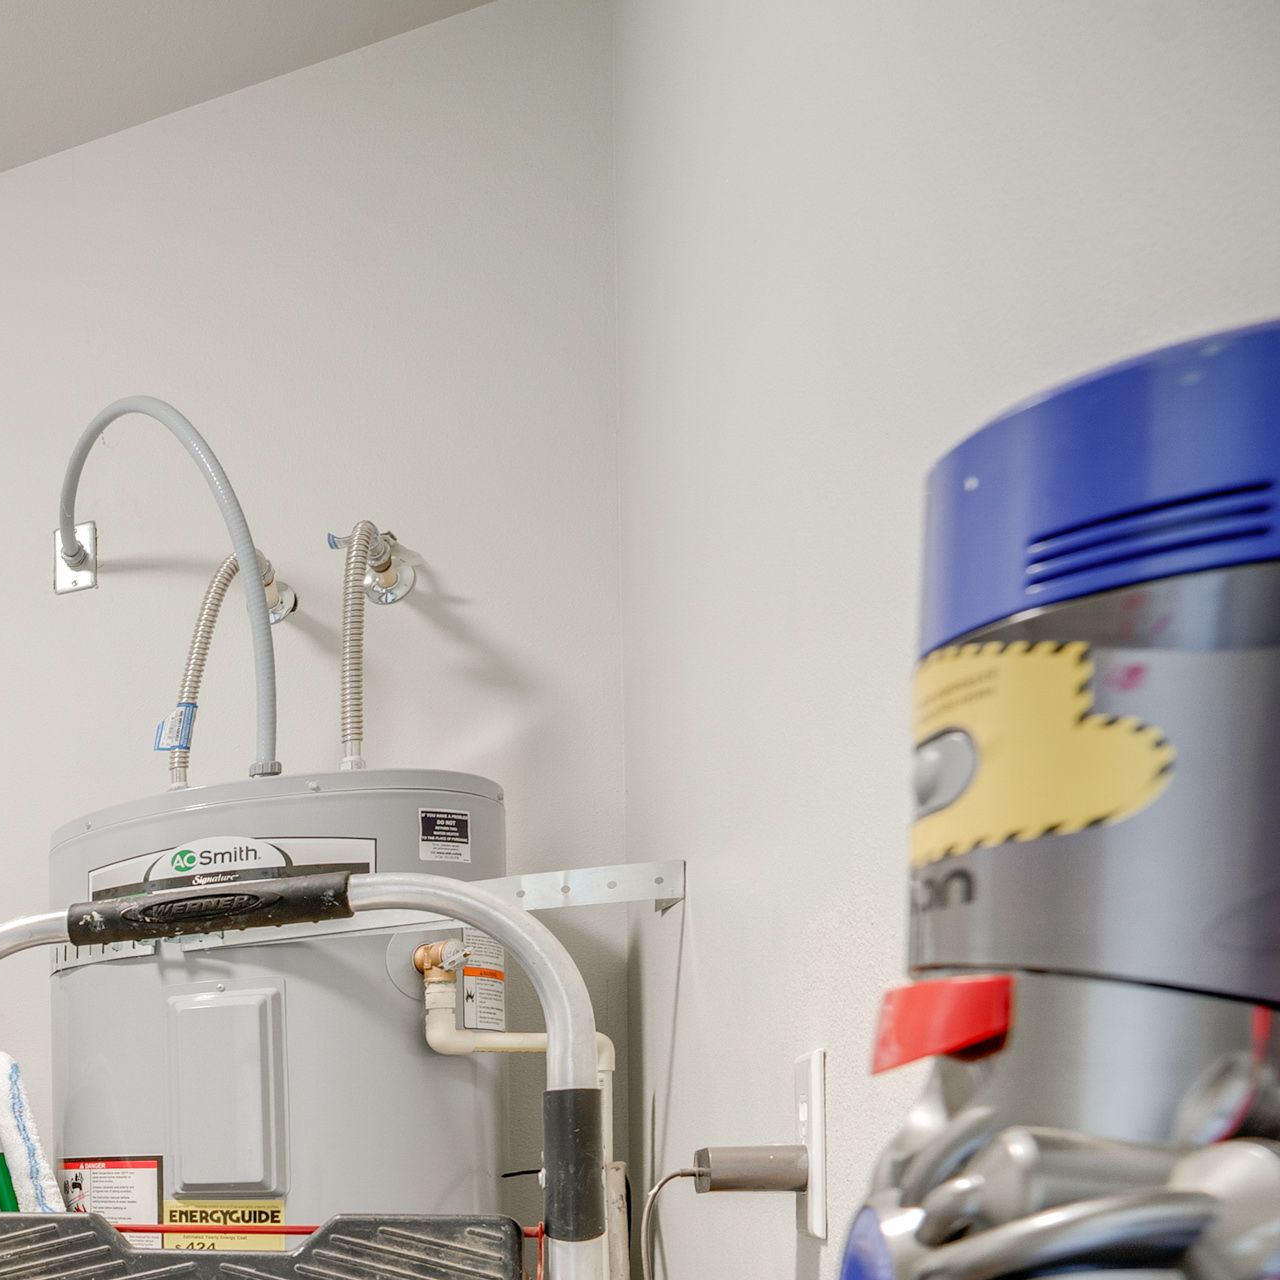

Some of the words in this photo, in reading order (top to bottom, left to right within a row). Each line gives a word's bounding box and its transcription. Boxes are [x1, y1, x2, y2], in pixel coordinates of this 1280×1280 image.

[200, 846, 258, 866] Smith
[192, 873, 236, 885] Signature
[151, 895, 249, 917] WERNER
[169, 1210, 281, 1225] ENERGYGUIDE
